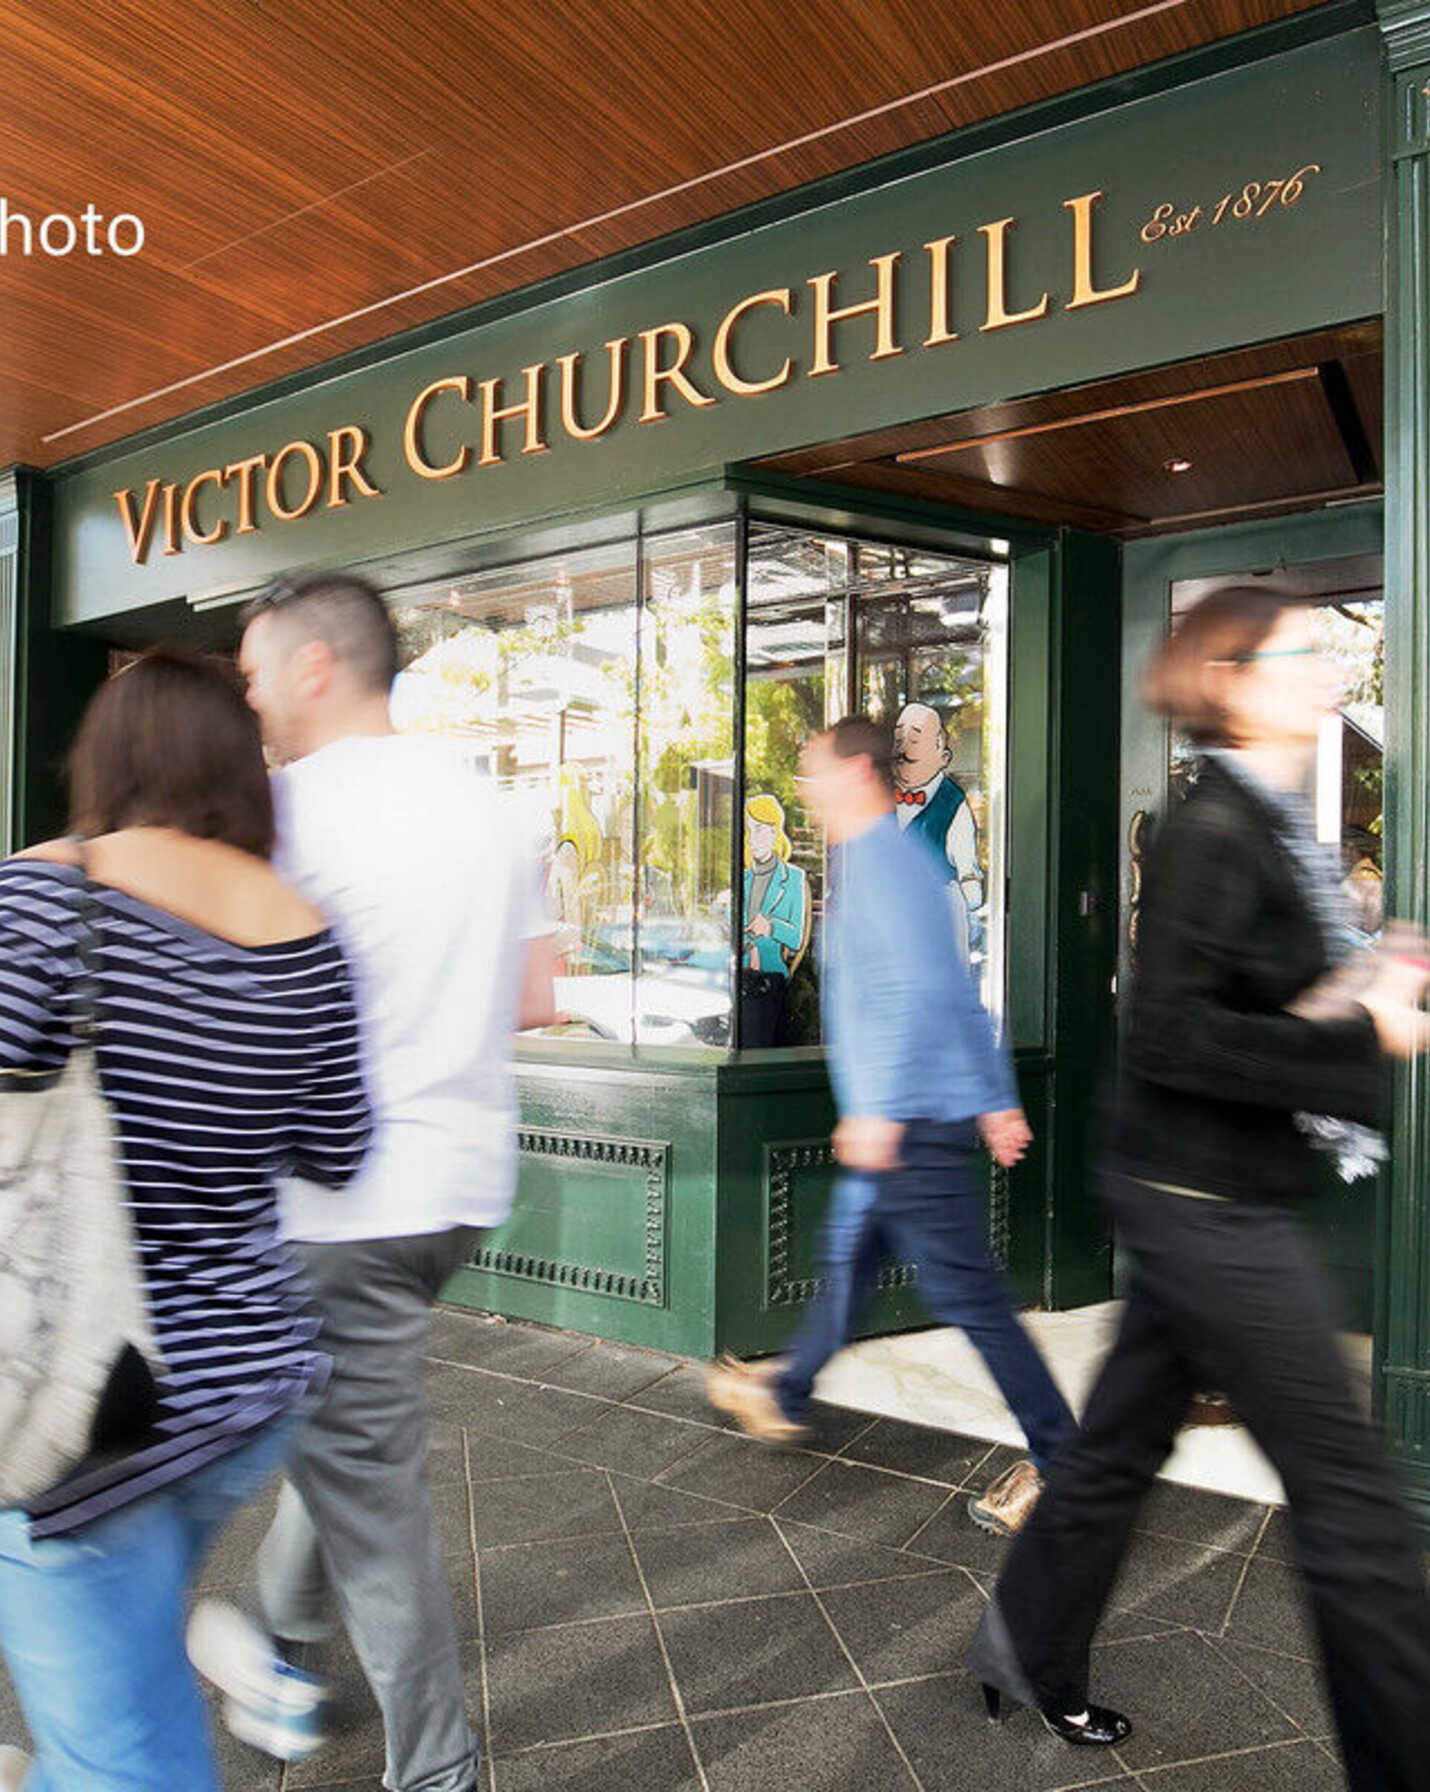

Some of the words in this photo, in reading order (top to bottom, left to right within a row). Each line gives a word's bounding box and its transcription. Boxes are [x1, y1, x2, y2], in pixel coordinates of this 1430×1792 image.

[1140, 203, 1201, 242] Est
[1211, 164, 1321, 225] 1876
[114, 424, 381, 564] VICTOR
[404, 191, 1140, 480] CHURCHILL
